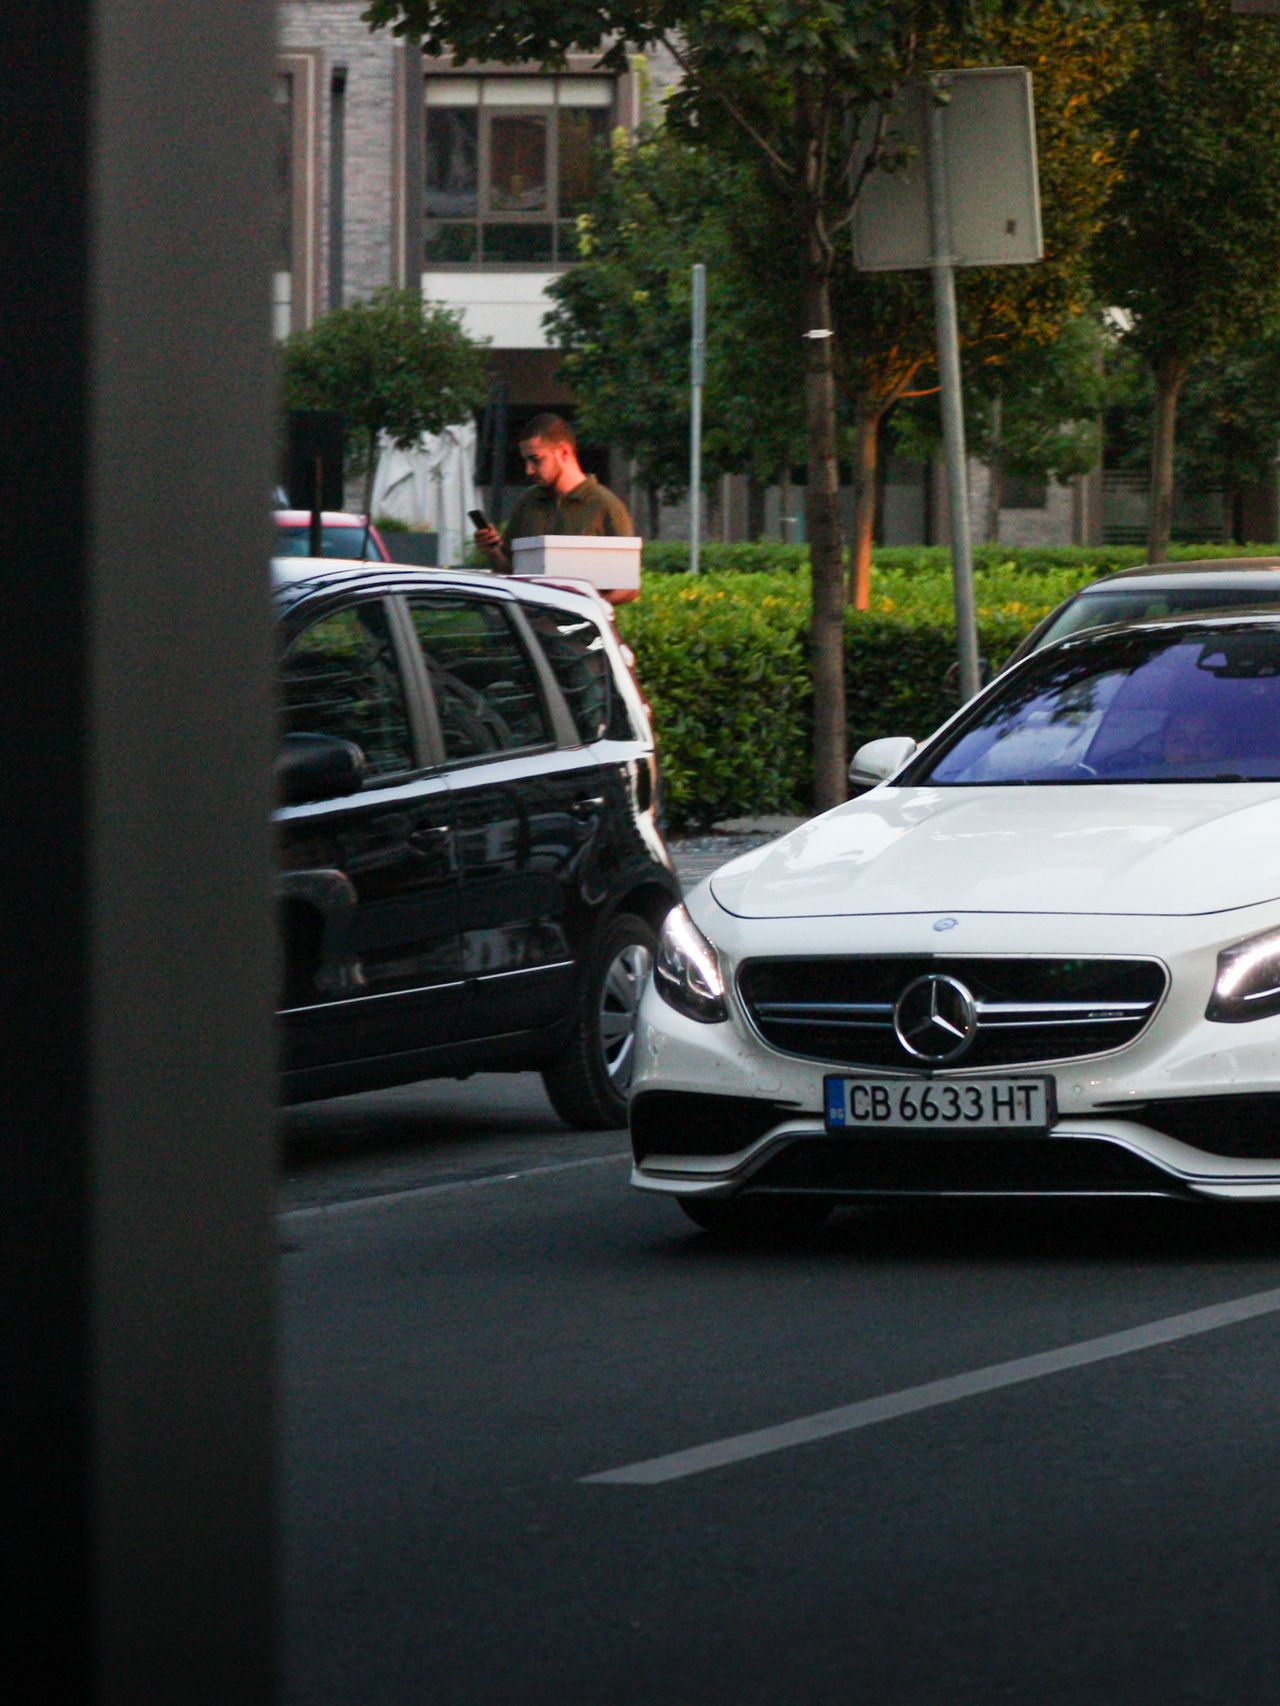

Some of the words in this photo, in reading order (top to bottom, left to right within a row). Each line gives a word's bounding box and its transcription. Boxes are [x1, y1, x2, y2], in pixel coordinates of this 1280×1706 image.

[849, 1084, 892, 1122] CB
[899, 1084, 985, 1122] 6633
[991, 1084, 1039, 1122] HT
